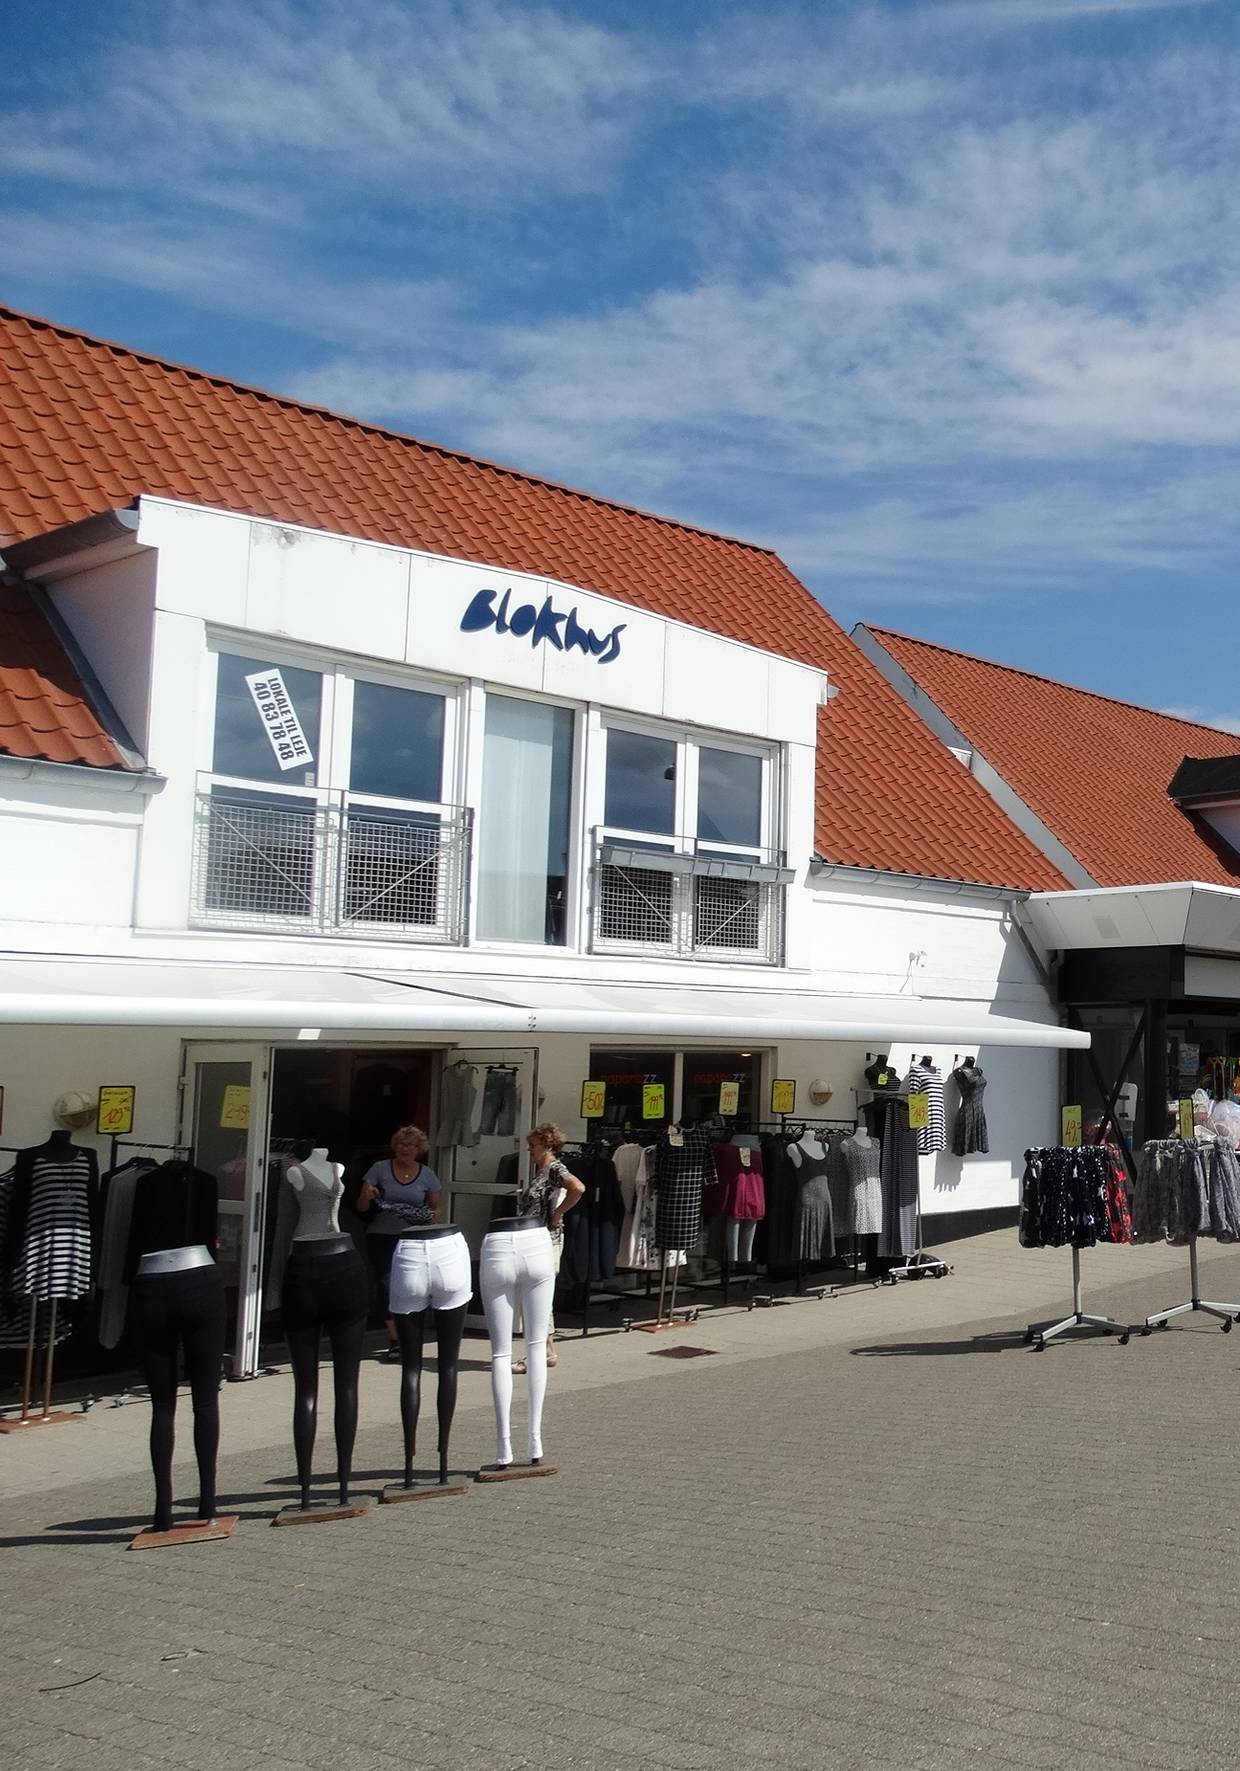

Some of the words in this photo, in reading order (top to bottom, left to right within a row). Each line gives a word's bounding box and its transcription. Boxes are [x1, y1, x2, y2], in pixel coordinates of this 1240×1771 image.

[254, 682, 271, 700] 40
[267, 677, 292, 717] LOKALE
[261, 702, 279, 721] 83
[269, 722, 287, 740] 78
[284, 716, 298, 734] TIL
[278, 742, 295, 760] 48
[290, 734, 308, 757] LEJE
